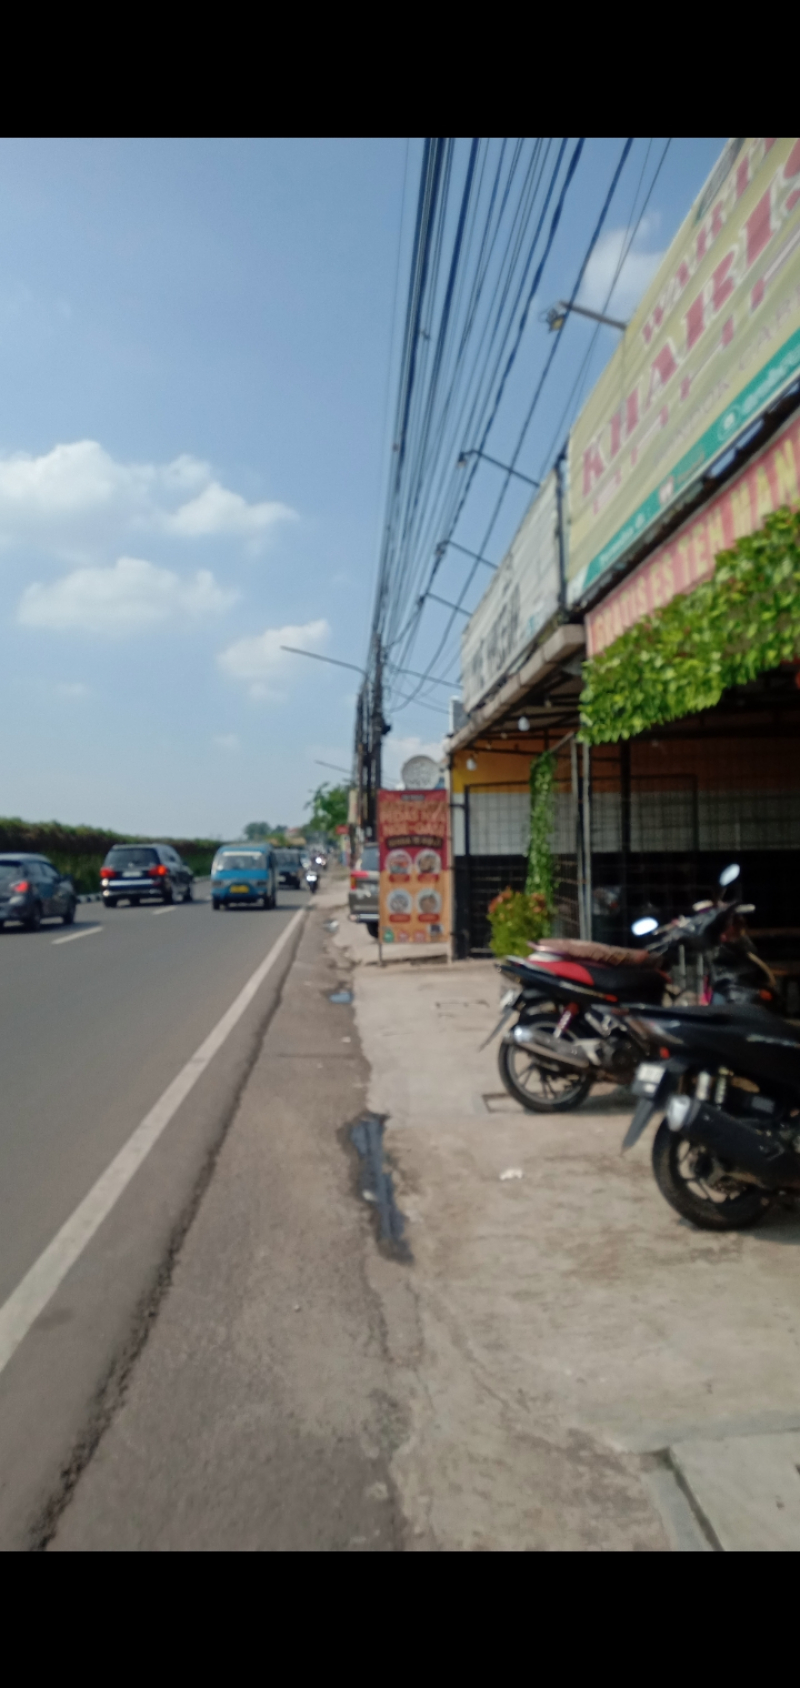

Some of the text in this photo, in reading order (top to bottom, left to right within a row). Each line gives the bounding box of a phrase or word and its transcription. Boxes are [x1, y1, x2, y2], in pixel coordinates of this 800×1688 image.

[641, 137, 778, 345] WART
[650, 552, 674, 608] ES
[678, 505, 725, 588] TEH
